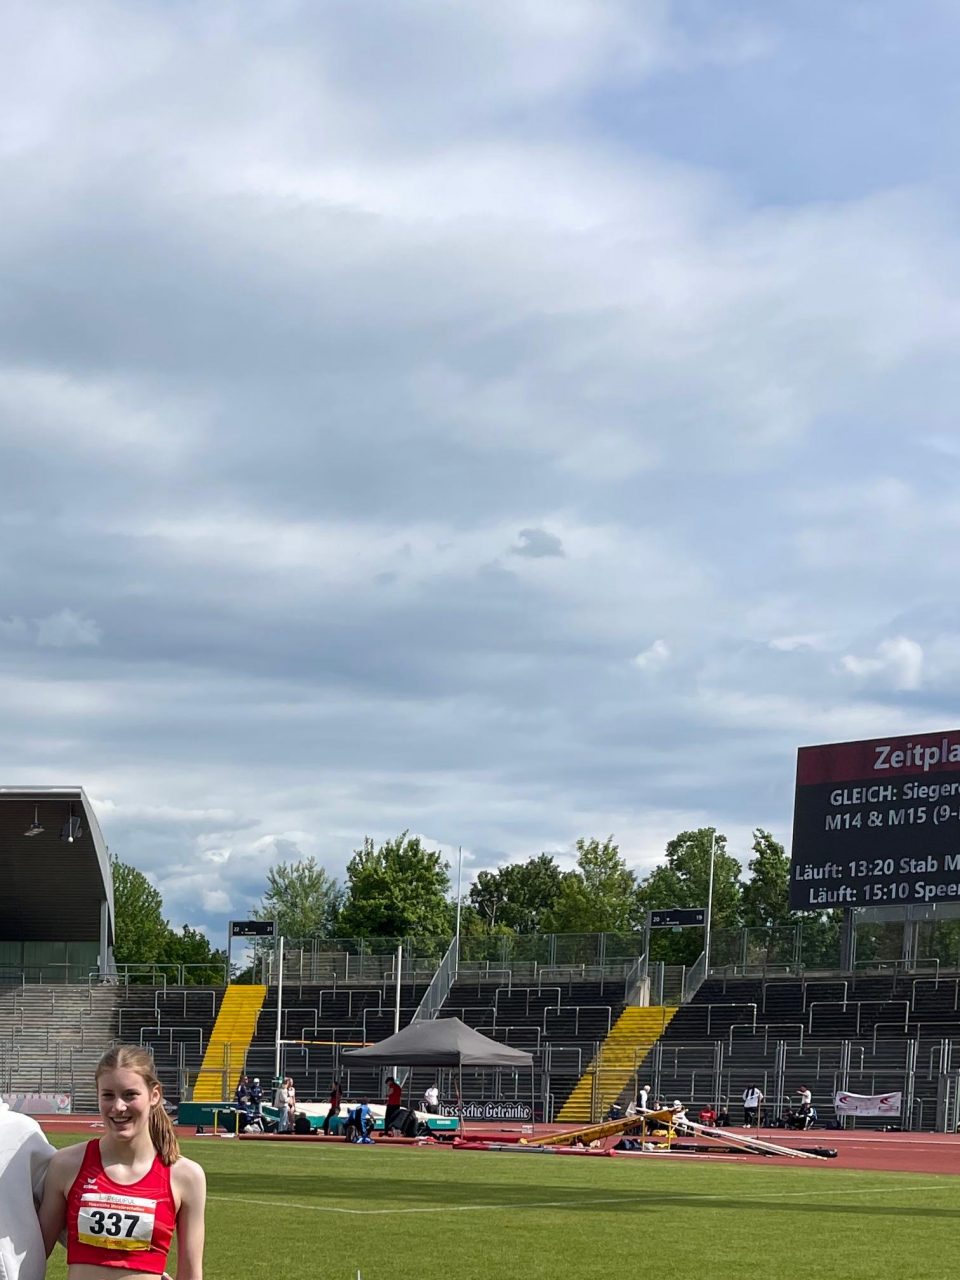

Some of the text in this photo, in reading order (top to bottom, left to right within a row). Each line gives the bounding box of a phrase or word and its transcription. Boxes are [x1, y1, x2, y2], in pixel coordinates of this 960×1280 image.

[874, 739, 960, 771] Zeitpla
[830, 785, 897, 806] GLEICH:
[825, 811, 863, 831] M14
[867, 811, 883, 827] &
[888, 807, 927, 825] M15
[795, 862, 842, 881] Läuft:
[848, 859, 894, 877] 13:20
[899, 855, 938, 874] Stab
[809, 885, 857, 904] Läuft:
[863, 882, 910, 900] 15:10
[485, 1103, 532, 1118] Getränke
[89, 1210, 140, 1238] 337
